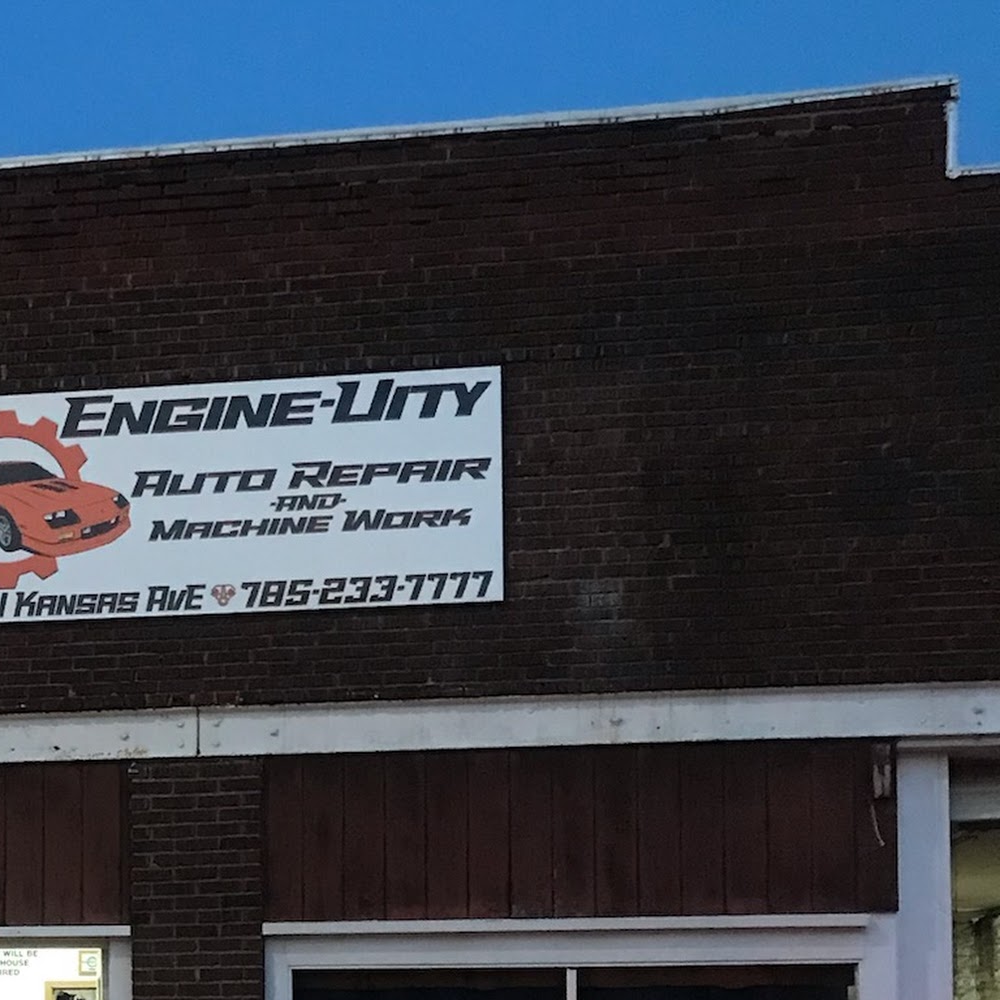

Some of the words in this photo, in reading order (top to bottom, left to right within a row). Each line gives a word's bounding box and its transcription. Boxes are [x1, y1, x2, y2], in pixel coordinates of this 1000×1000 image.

[60, 379, 492, 438] ENGINE-UITY
[131, 469, 279, 498] AUTO
[288, 457, 492, 490] REPAIR
[148, 515, 331, 542] MACHINE
[342, 508, 473, 532] WORK
[13, 591, 140, 618] KANSAS
[241, 571, 494, 609] 785-233-7777
